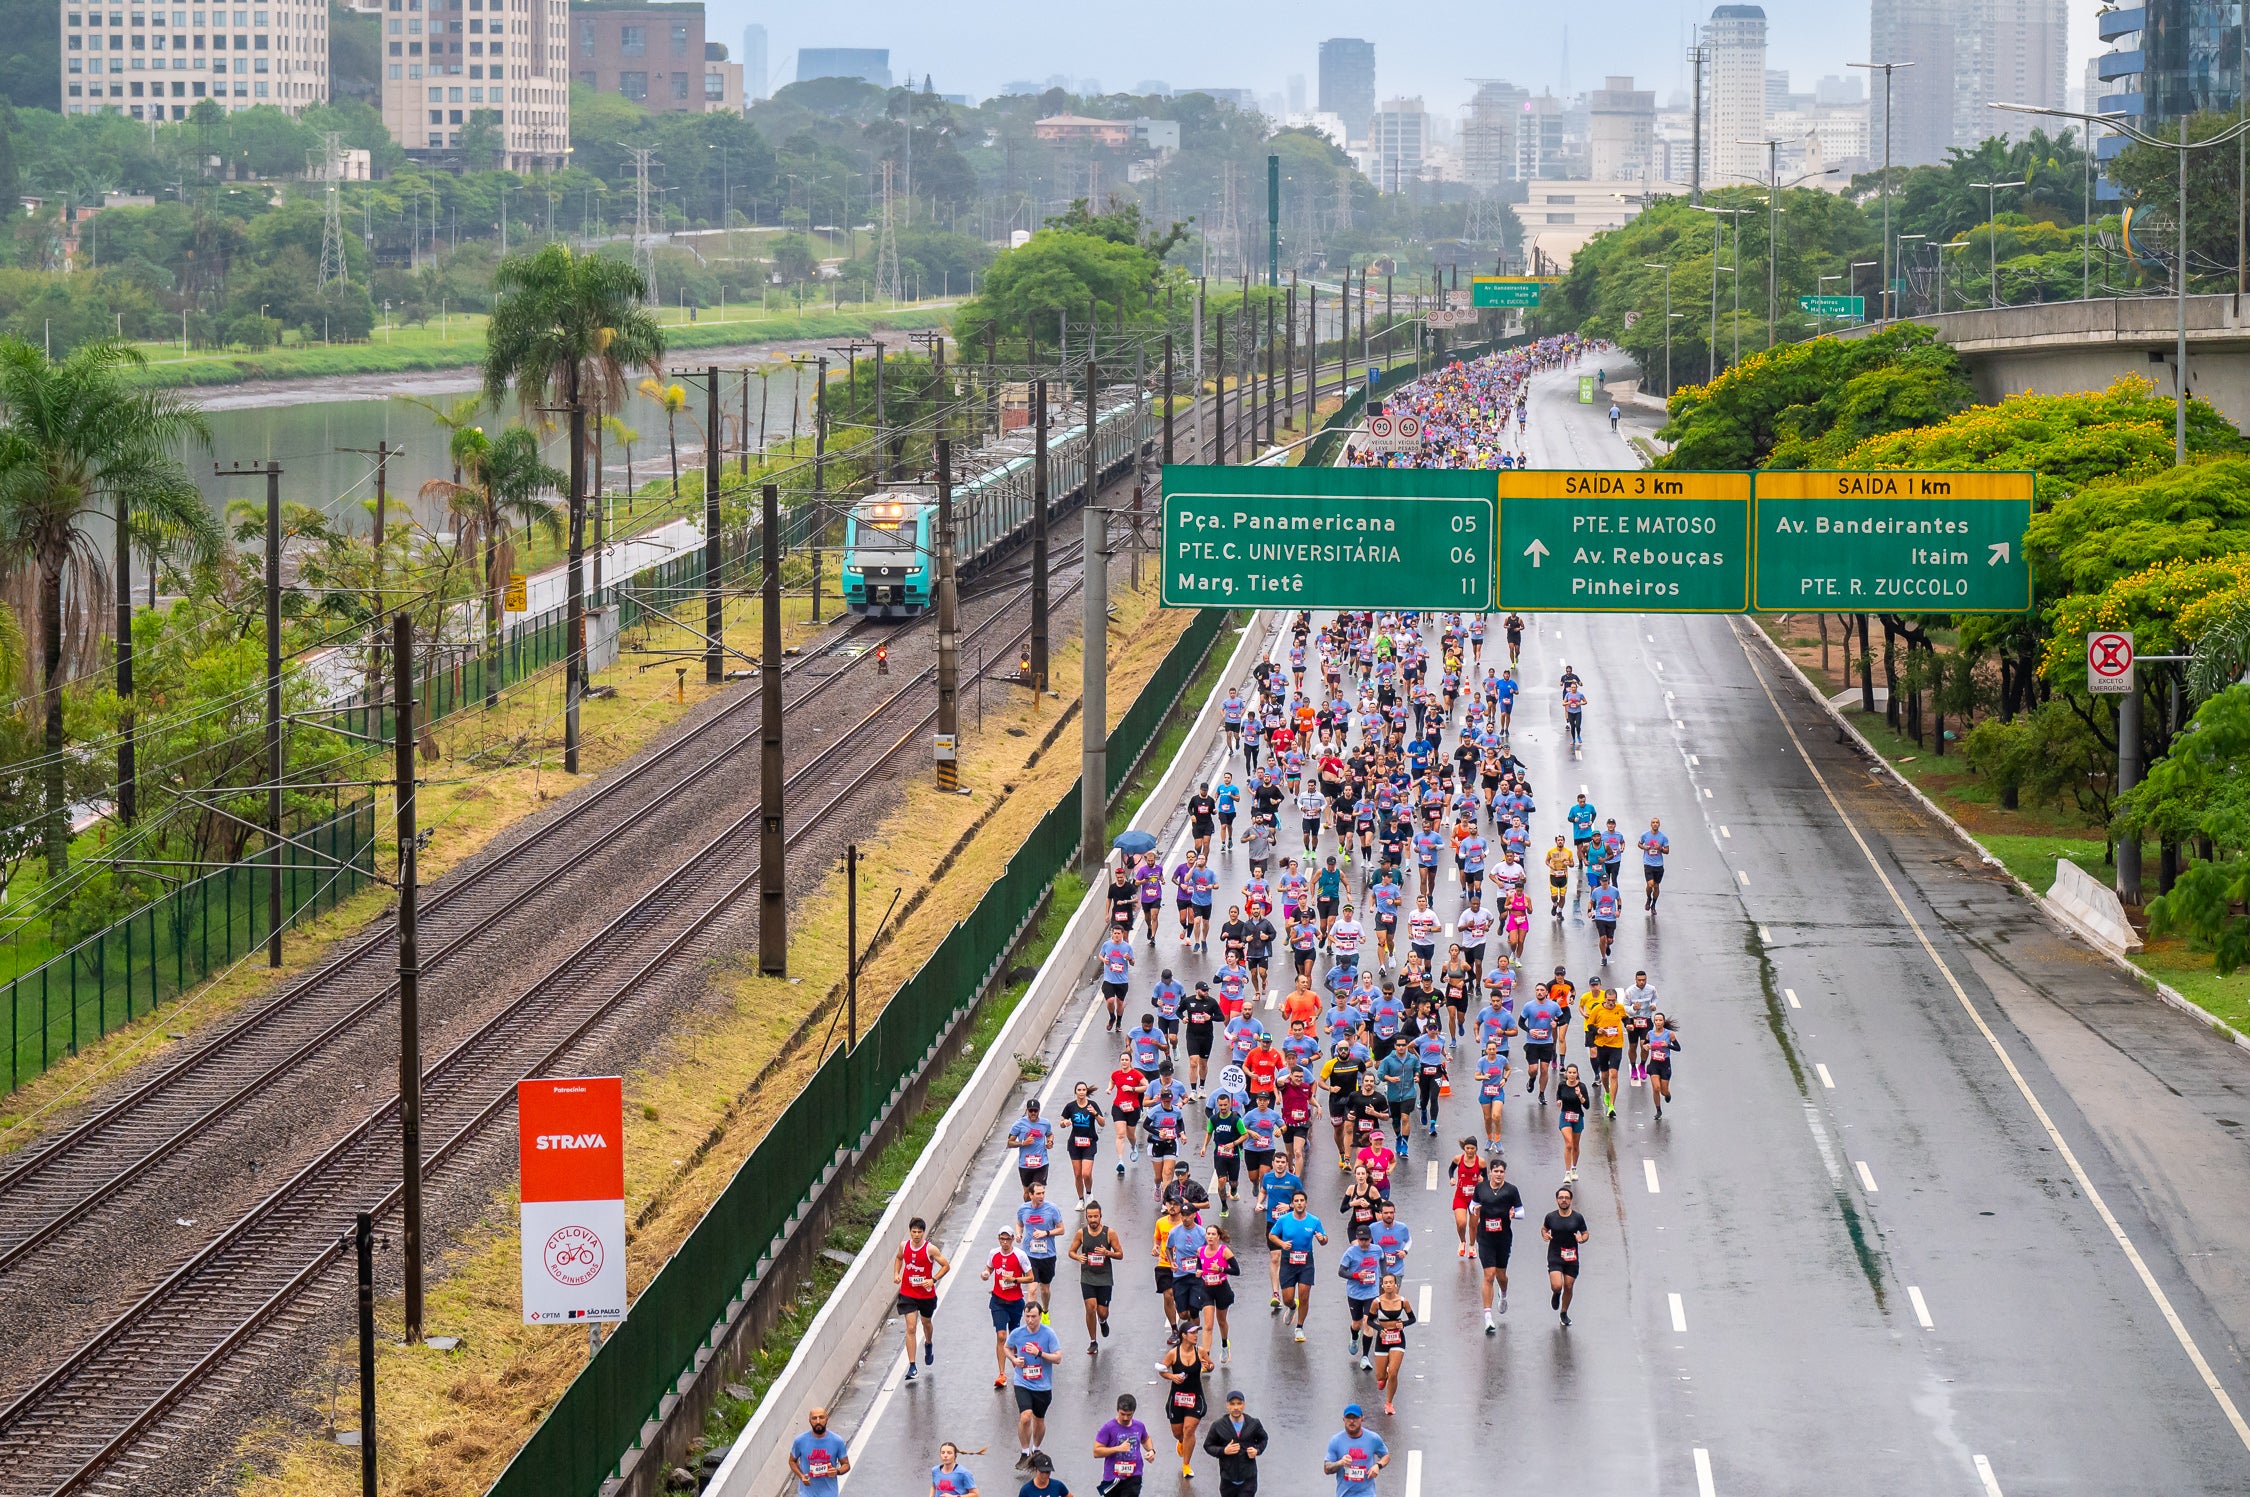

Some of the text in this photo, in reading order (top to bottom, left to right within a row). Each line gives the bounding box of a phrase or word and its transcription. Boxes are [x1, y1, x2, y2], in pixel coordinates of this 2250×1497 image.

[1810, 306, 1827, 314] Mag.
[1581, 391, 1591, 399] 12
[1376, 423, 1388, 431] 90
[1403, 423, 1415, 431] 60
[1566, 472, 1683, 495] SAÍDA 3 km
[1838, 472, 1951, 495] SAÍDA 1 km
[1179, 511, 1395, 533] Pça. Panamericana
[1451, 515, 1477, 533] 05
[1573, 516, 1614, 533] PTE.
[1636, 516, 1716, 535] MATOSO
[1775, 516, 1969, 534] Av. Bandeirantes
[1179, 542, 1220, 560] PTE.
[1249, 538, 1401, 563] UNIVERSITÁRIA
[1450, 546, 1476, 563] 06
[1573, 547, 1724, 567] Av. Rebouças
[1911, 548, 1969, 565] Itaim
[1178, 572, 1303, 595] Marg. Tietê
[1461, 577, 1476, 595] 11
[1572, 577, 1680, 596] Pinheiros
[1801, 578, 1968, 596] PTE. R. ZUCCOLO
[1223, 1072, 1243, 1084] 2:05
[536, 1133, 607, 1150] STRAVA
[549, 1228, 598, 1250] CICLOVIA
[551, 1263, 562, 1277] RIO
[561, 1262, 599, 1284] PINHEIROS
[587, 1307, 599, 1315] SÃO
